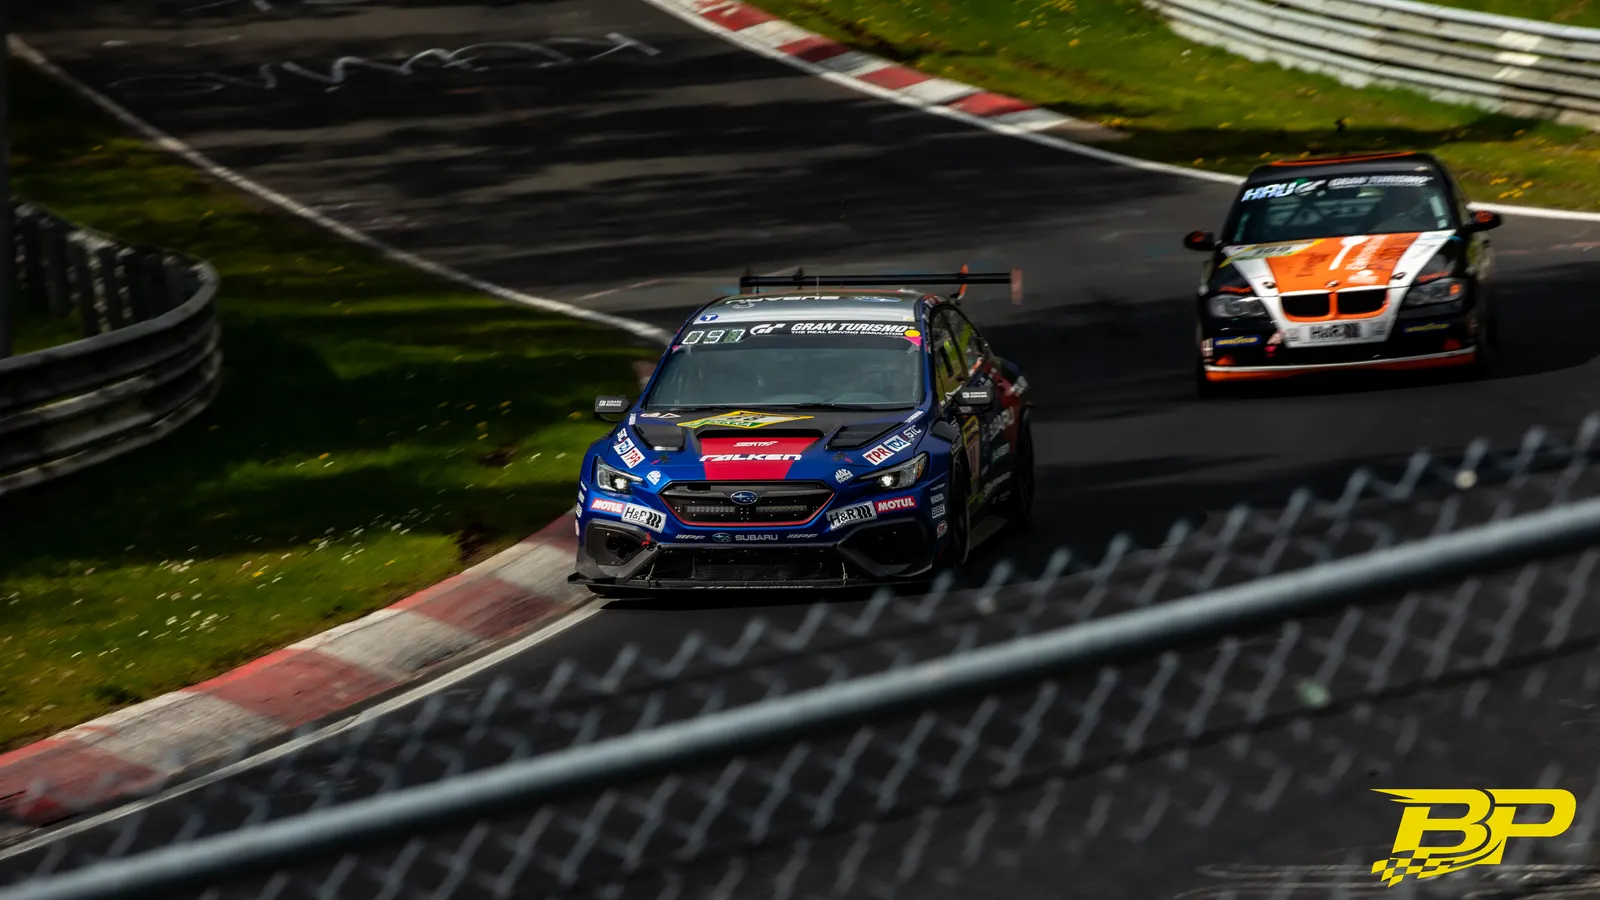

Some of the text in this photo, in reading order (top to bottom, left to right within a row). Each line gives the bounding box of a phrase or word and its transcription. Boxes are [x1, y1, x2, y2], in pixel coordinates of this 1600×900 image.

[791, 322, 837, 331] GRAN
[838, 323, 908, 333] TURISMO
[625, 449, 641, 466] TPR
[699, 453, 803, 462] FALKEN
[866, 448, 892, 463] TPR
[592, 499, 624, 513] MOTUL
[878, 498, 915, 512] MOTUL
